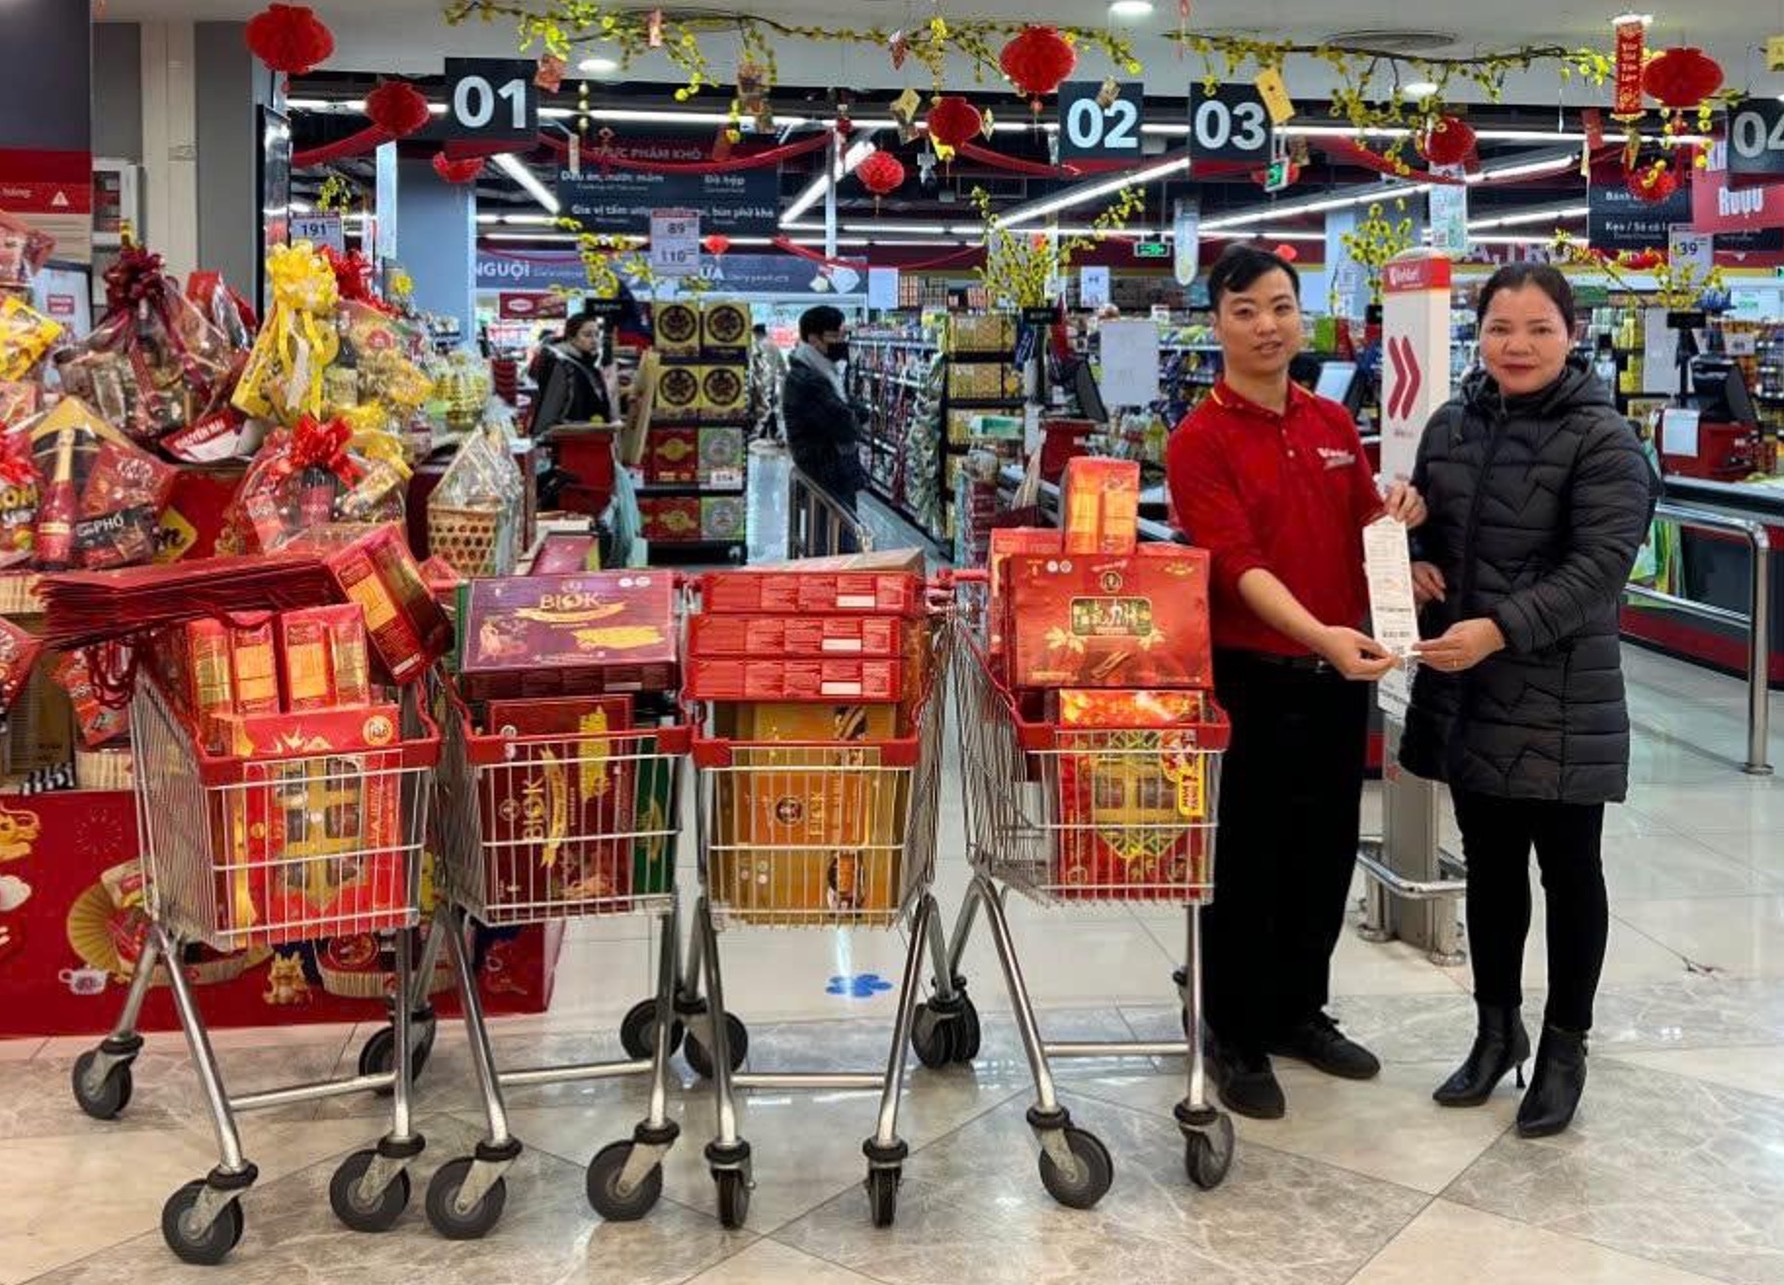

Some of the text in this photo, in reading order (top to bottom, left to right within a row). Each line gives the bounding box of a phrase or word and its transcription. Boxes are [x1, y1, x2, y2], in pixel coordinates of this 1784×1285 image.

[453, 75, 527, 130] 01
[1066, 99, 1139, 149] 02
[1195, 100, 1266, 150] 03
[301, 223, 327, 236] 191
[667, 222, 686, 235] 89
